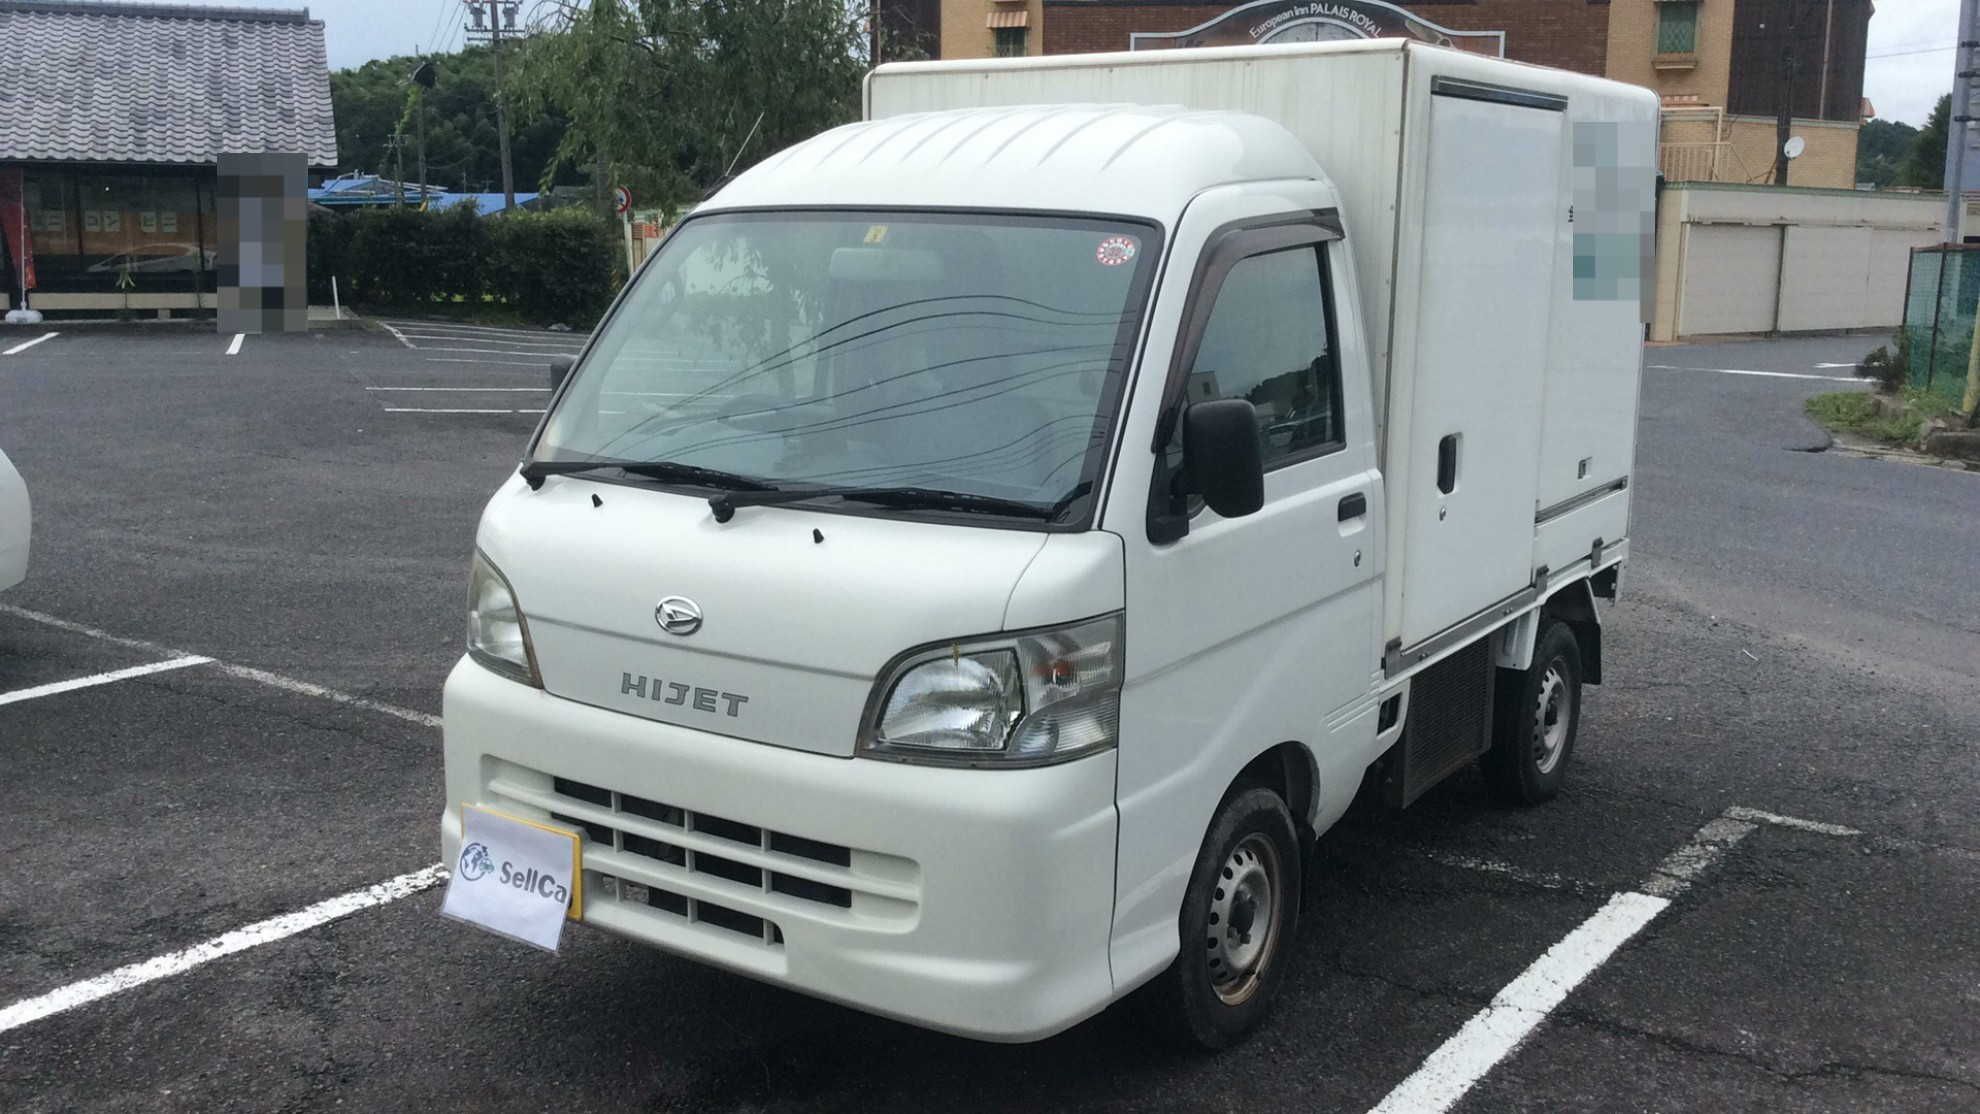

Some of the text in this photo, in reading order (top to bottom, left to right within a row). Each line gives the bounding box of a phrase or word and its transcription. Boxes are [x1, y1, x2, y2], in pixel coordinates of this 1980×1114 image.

[1249, 9, 1294, 38] European
[1310, 3, 1349, 18] PALAIS
[1348, 9, 1384, 38] ROYAL
[621, 672, 749, 717] HIJET
[499, 861, 568, 904] SellCa
